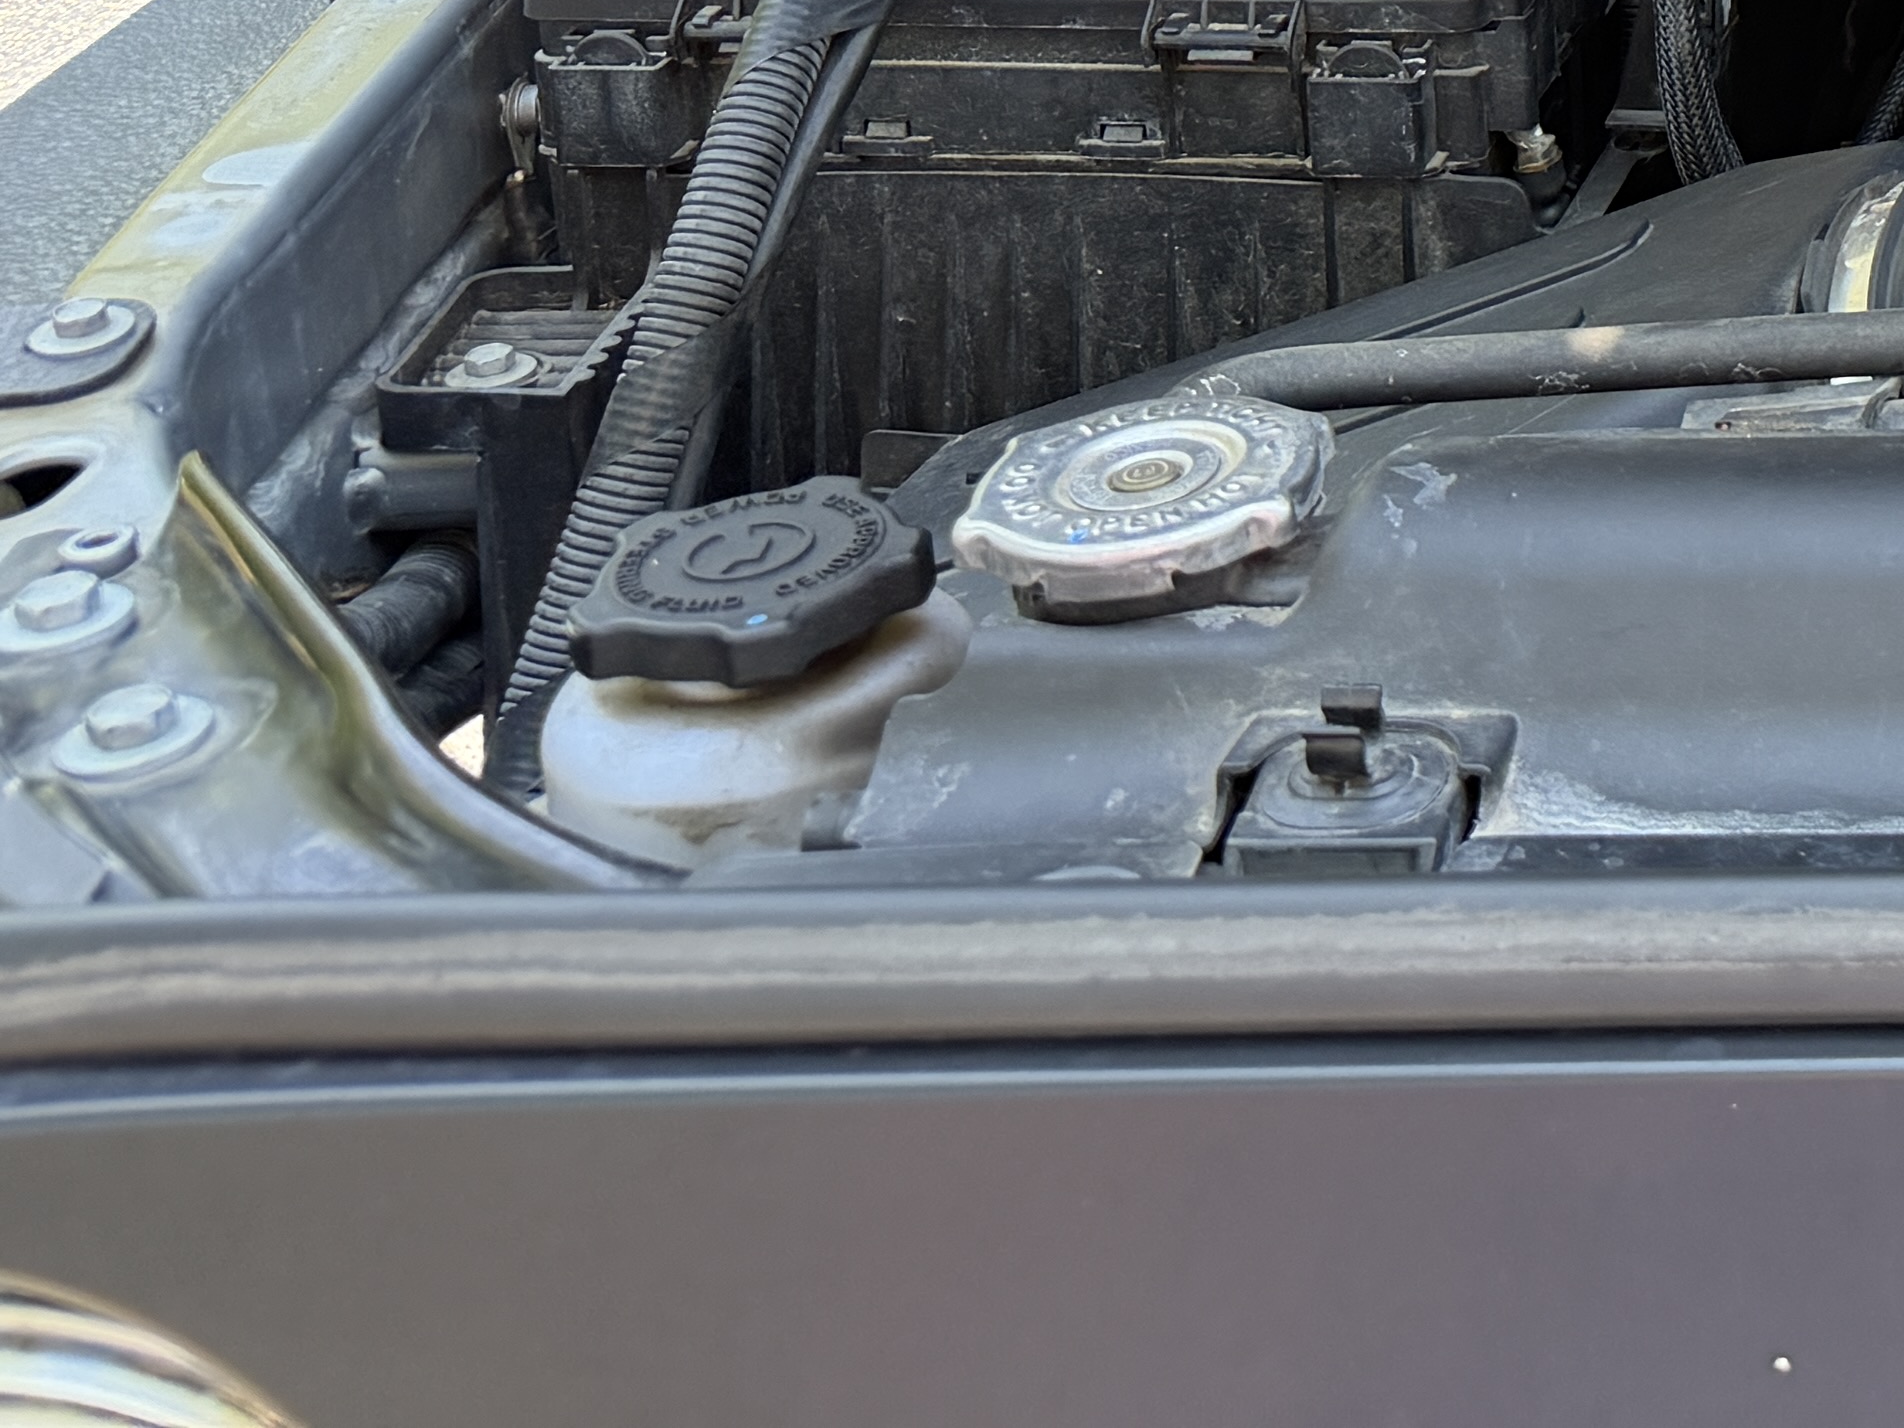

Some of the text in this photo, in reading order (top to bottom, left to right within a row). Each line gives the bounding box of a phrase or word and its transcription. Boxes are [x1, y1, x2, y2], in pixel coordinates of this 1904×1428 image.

[1078, 402, 1194, 437] KEEP
[681, 491, 807, 526] POWER
[1065, 506, 1184, 535] OPEN
[775, 494, 879, 596] USE APPROVED
[616, 527, 678, 604] STEERING
[650, 596, 744, 612] FLUID
